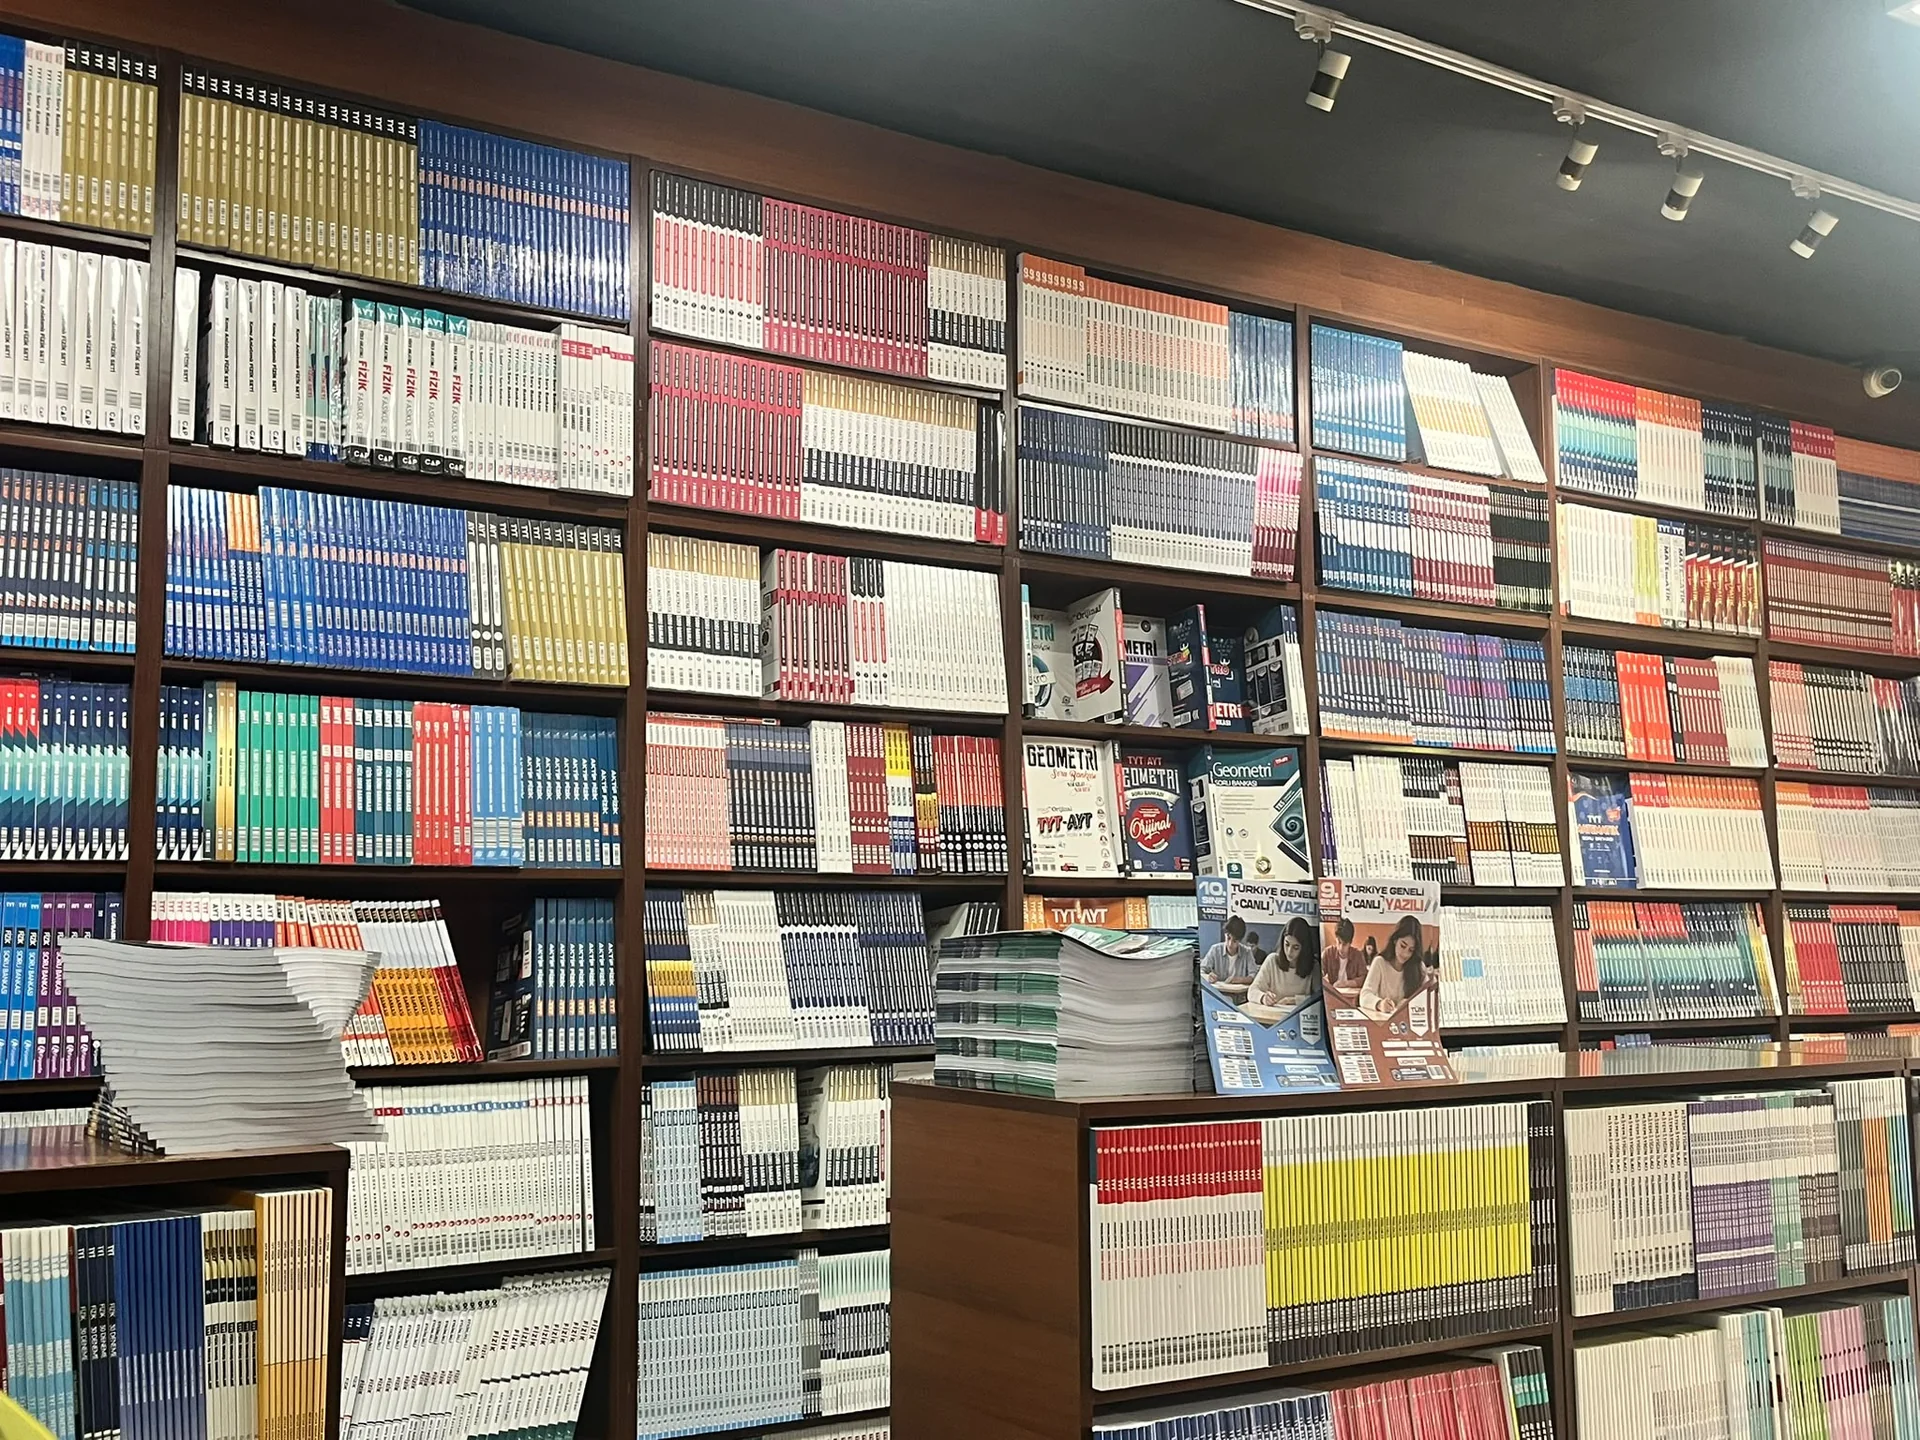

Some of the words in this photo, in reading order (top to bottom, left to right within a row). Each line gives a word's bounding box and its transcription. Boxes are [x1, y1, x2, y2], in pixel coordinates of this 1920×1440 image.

[67, 48, 75, 63] TYT
[81, 51, 89, 65] TYT
[95, 54, 103, 69] TYT
[107, 57, 115, 71] TYT
[122, 59, 130, 74] TYT
[135, 62, 143, 77] TYT
[148, 65, 156, 79] TYT
[197, 76, 205, 90] TYT
[222, 80, 230, 94] TYT
[358, 360, 369, 391] FİZİK
[382, 364, 393, 395] FİZİK
[407, 368, 417, 398] FİZİK
[429, 370, 440, 400] FİZİK
[453, 375, 463, 405] FİZİK
[521, 525, 529, 539] TYT
[533, 526, 541, 540] TYT
[579, 532, 587, 545] TYT
[591, 533, 599, 546] TYT
[1027, 744, 1098, 771] GEOMETRİ
[1128, 756, 1143, 764] TYT
[1147, 757, 1162, 765] AYT
[1213, 762, 1272, 778] Geometri
[1122, 767, 1180, 793] EOMETRİ
[1587, 815, 1601, 823] TYT
[1130, 813, 1171, 840] Orijinal
[1199, 881, 1226, 896] 10.
[1232, 883, 1277, 896] TÜRKİYE
[1321, 882, 1339, 898] 9.
[1345, 884, 1387, 894] TÜRKİYE
[1390, 887, 1424, 896] GENELİ
[1202, 896, 1226, 904] SINIF
[1240, 899, 1269, 910] CANLI
[1353, 899, 1380, 909] CANLI
[1386, 898, 1424, 911] YAZILI
[1052, 909, 1077, 923] TYT
